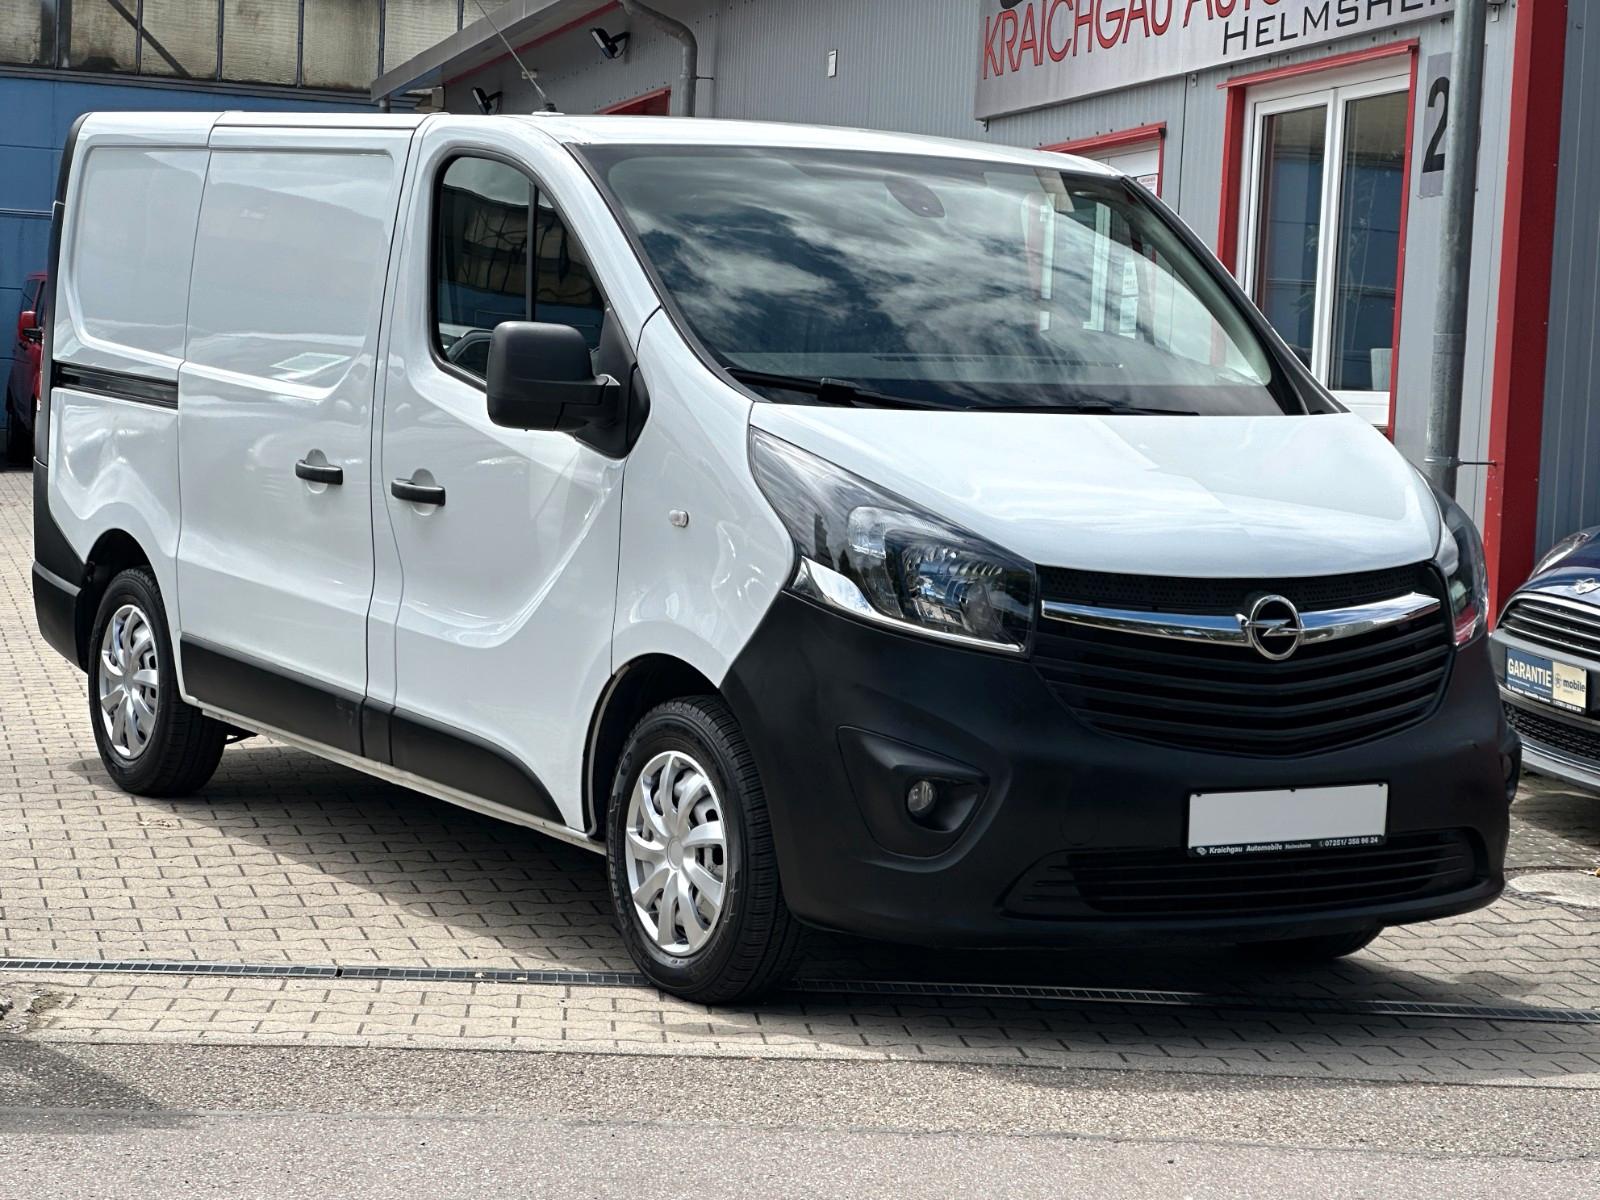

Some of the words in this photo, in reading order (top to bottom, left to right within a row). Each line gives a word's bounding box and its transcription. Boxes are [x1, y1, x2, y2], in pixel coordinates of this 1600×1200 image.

[1422, 76, 1450, 173] 2
[1508, 658, 1552, 688] GARANTIE
[1563, 679, 1585, 692] mobile
[1209, 846, 1243, 855] Kraichgau
[1246, 843, 1283, 852] Automobile
